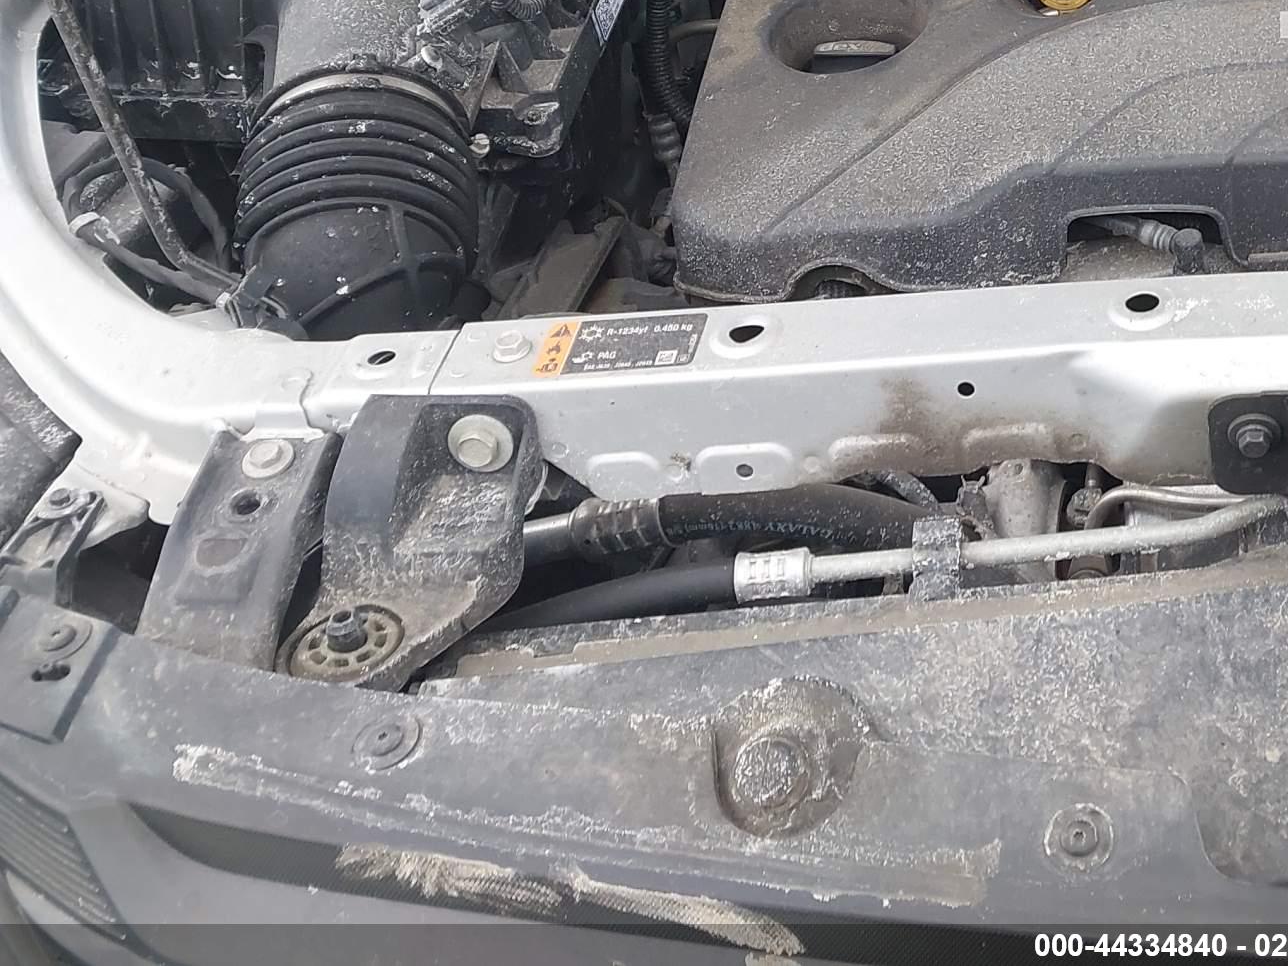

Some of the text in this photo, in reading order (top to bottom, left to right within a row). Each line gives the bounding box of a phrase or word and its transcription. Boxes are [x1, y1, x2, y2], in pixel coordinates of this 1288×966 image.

[607, 325, 649, 336] R-1234yf
[681, 323, 693, 332] kg
[597, 351, 616, 360] PAG
[764, 521, 833, 540] GALAXY
